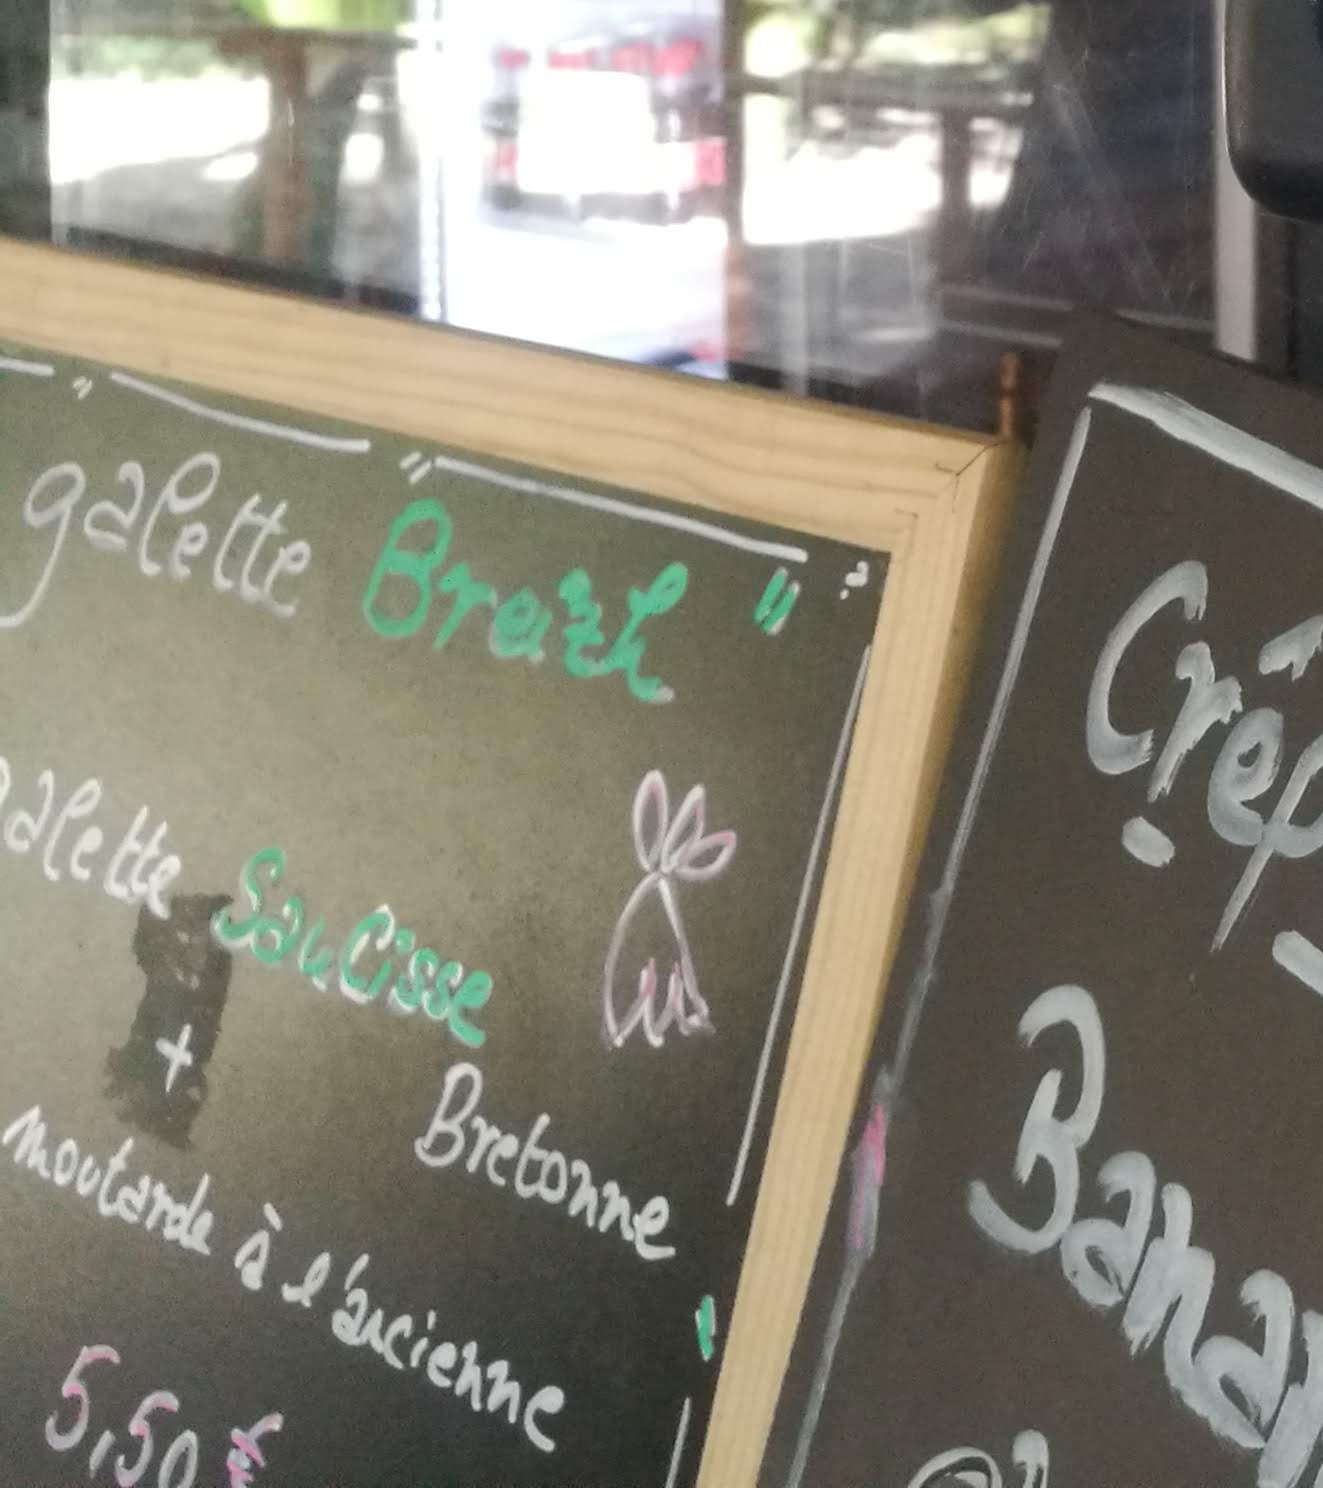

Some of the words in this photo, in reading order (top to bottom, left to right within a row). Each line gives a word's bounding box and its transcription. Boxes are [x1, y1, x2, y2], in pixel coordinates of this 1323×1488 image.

[0, 452, 312, 628] galette
[415, 1061, 676, 1262] Bretonne
[1, 1104, 211, 1256] moutarde
[234, 1203, 283, 1291] à
[281, 1251, 565, 1453] l'ancienne
